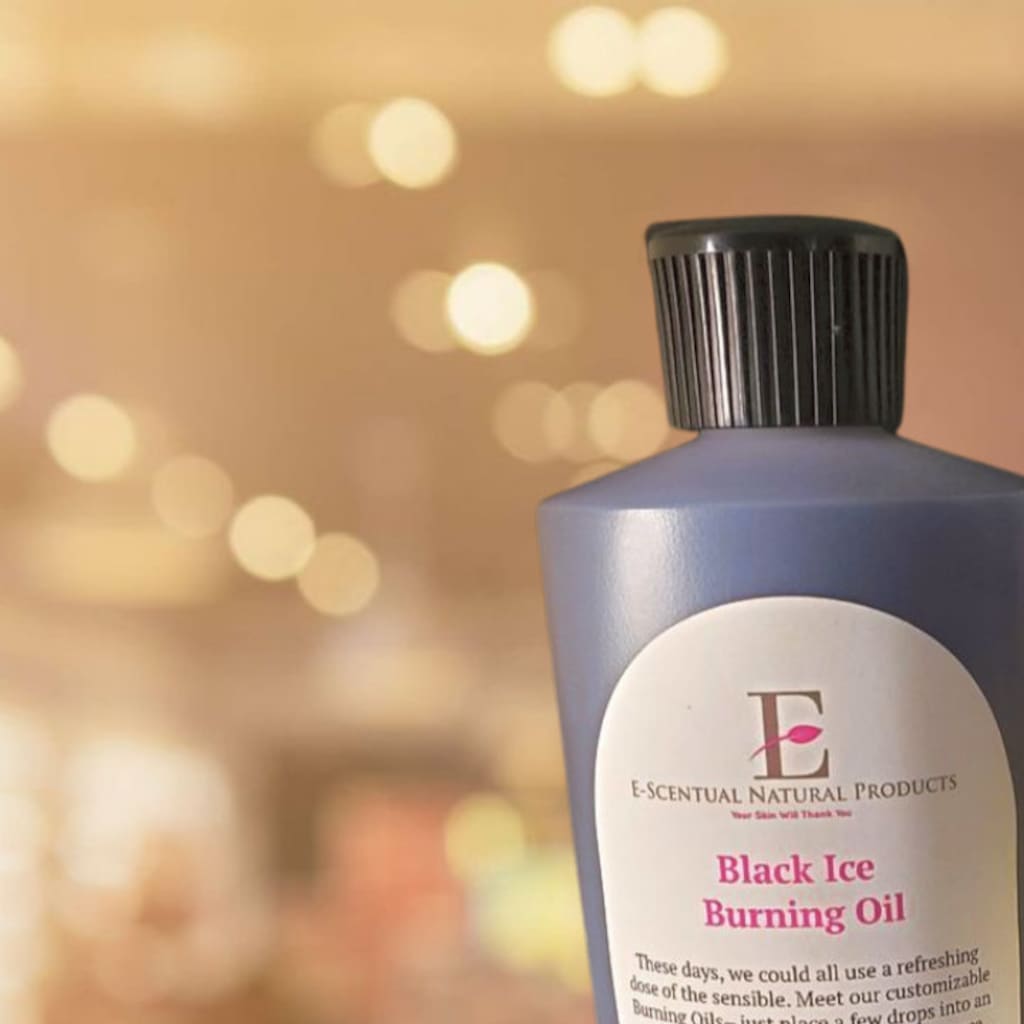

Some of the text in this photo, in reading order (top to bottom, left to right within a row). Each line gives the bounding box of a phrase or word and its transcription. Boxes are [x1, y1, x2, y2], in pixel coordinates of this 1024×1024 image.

[749, 786, 847, 804] NATURAL
[855, 774, 957, 800] PRODUCTS
[717, 854, 875, 885] Black Ice
[703, 893, 906, 935] Burning Oil
[635, 947, 980, 984] These days, we could all use a refreshing
[630, 967, 991, 1008] dose of the sensible. Meet our customizable
[939, 996, 971, 1016] into
[974, 992, 992, 1010] an
